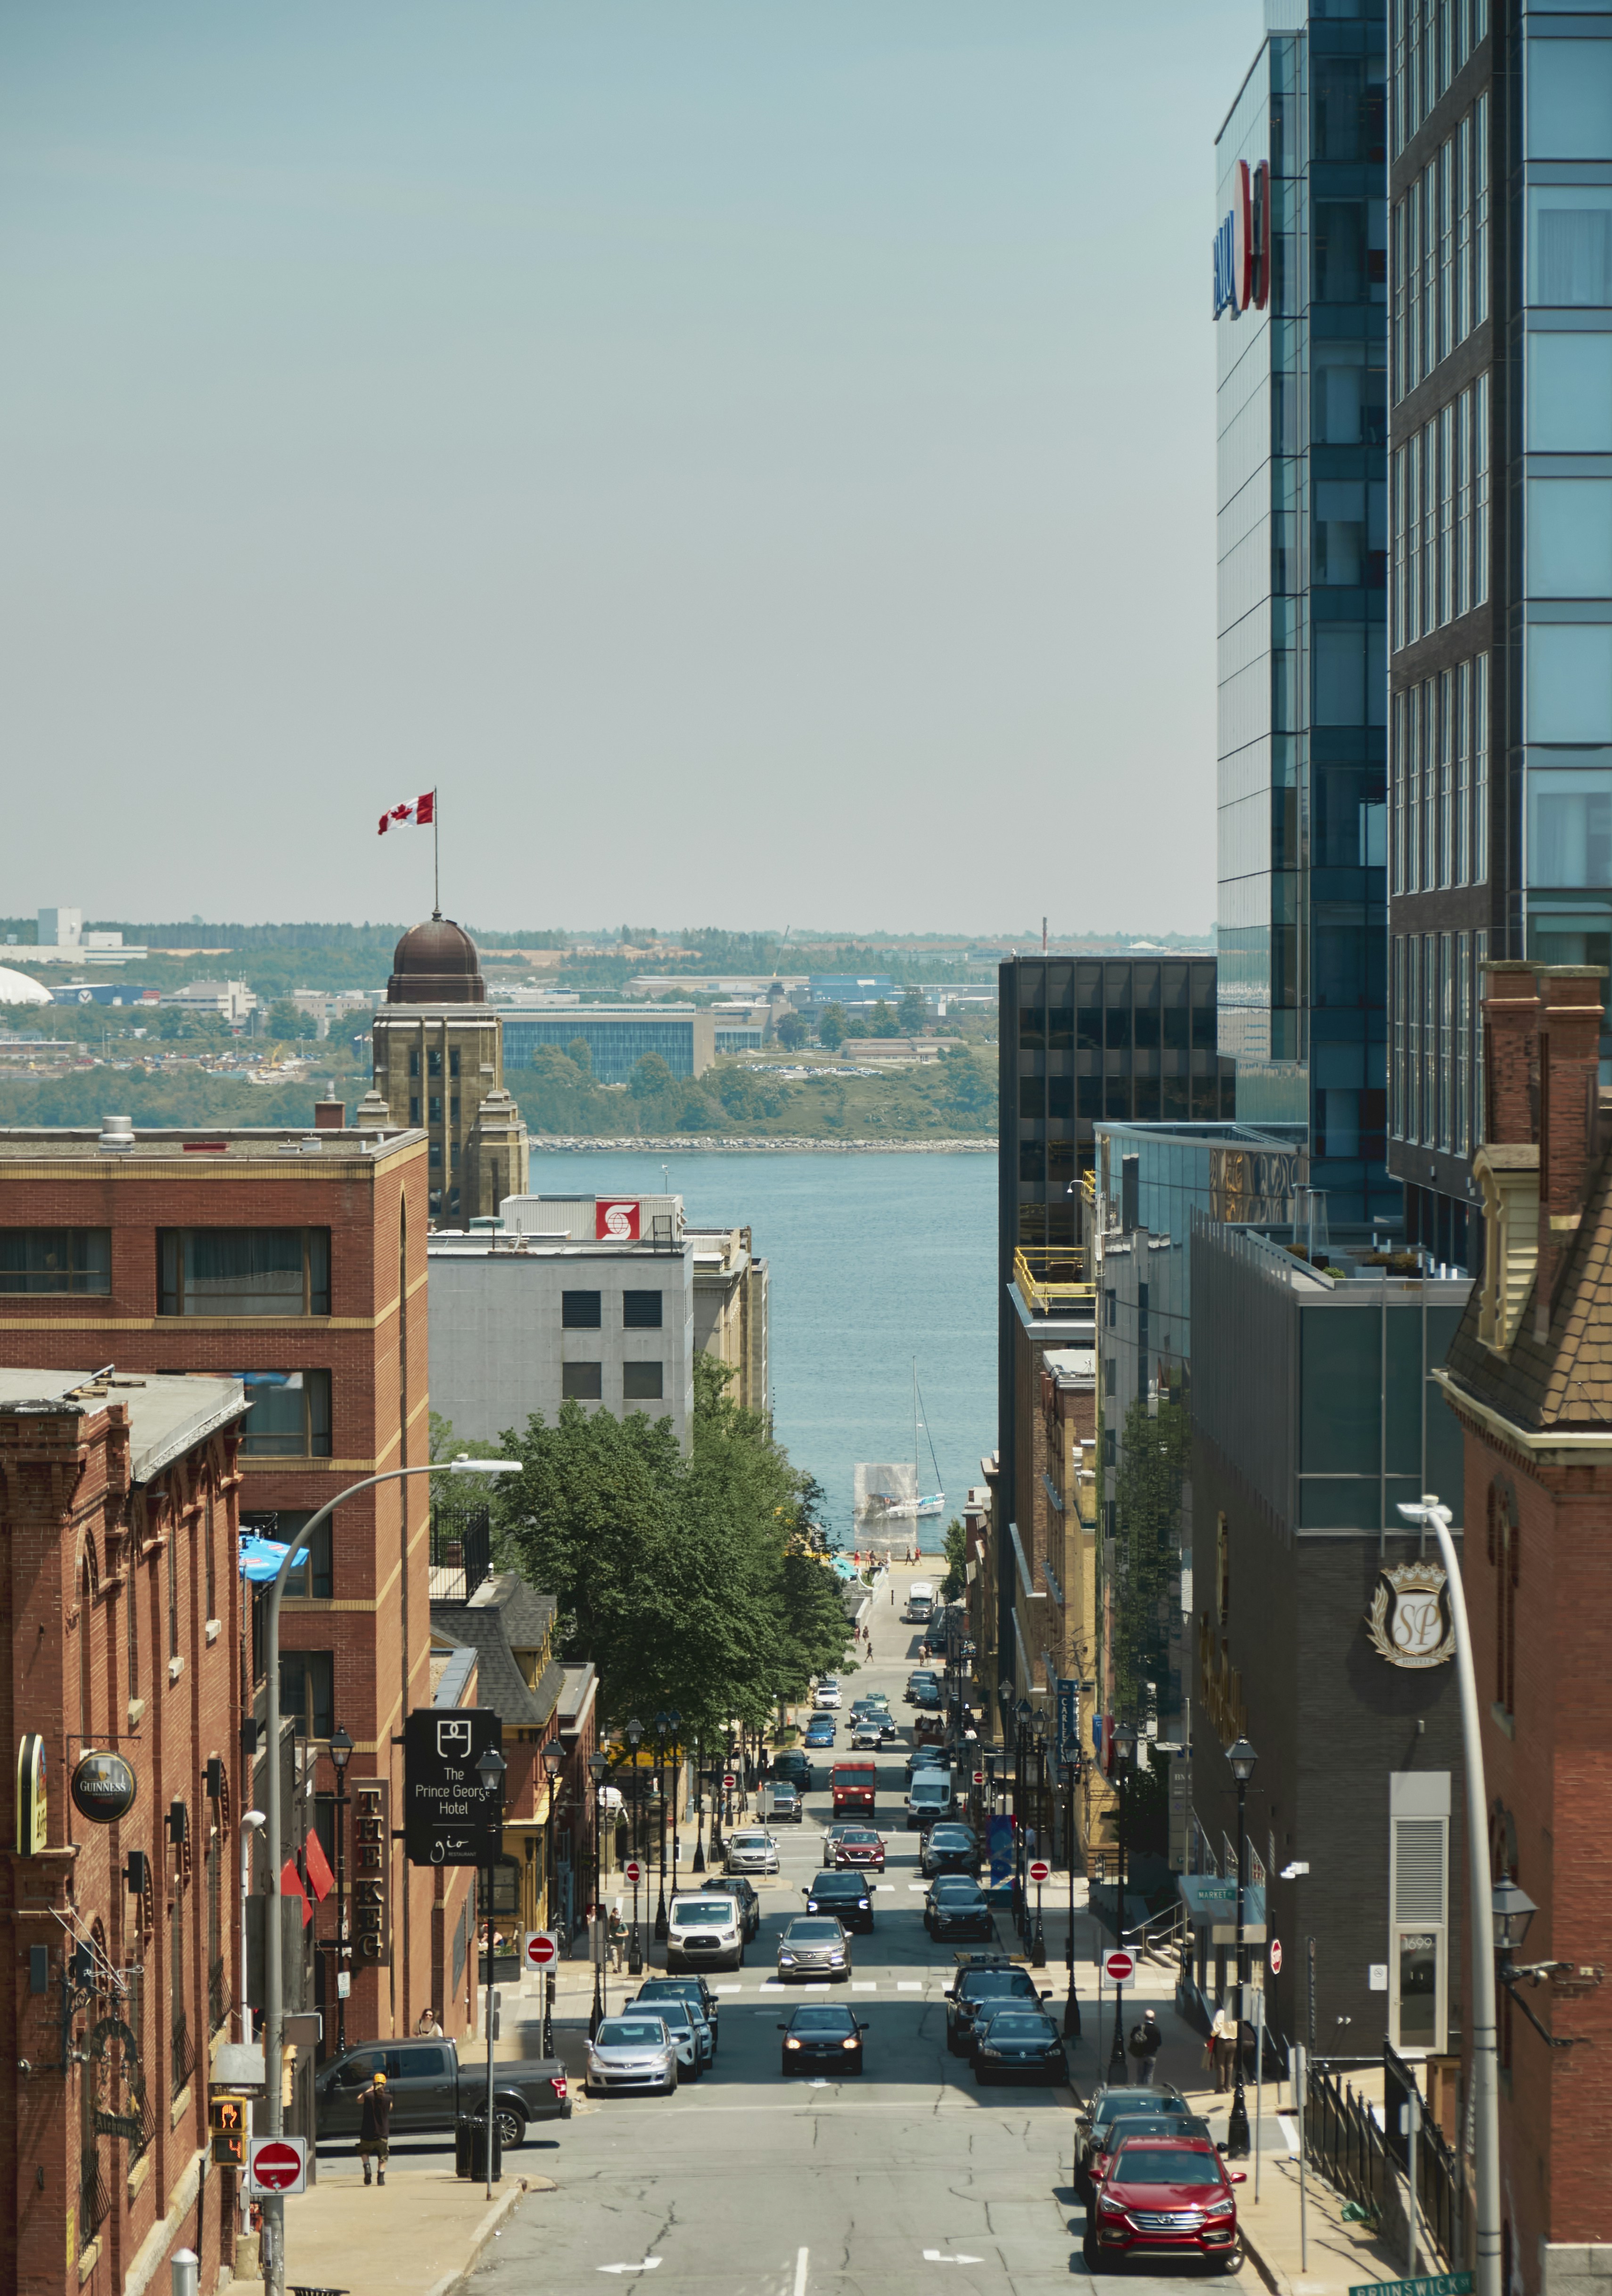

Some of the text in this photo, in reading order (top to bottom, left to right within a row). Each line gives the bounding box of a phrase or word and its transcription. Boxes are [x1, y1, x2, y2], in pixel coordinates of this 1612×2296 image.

[444, 1768, 464, 1780] The
[80, 1781, 126, 1792] GUINNESS
[415, 1785, 450, 1797] Prince
[439, 1802, 468, 1814] Hotel
[430, 1835, 469, 1863] gio
[356, 1788, 385, 1958] THE KEG
[1404, 1937, 1432, 1950] 1699
[229, 2139, 241, 2158] 4
[1357, 2277, 1458, 2296] BRUNSWICK
